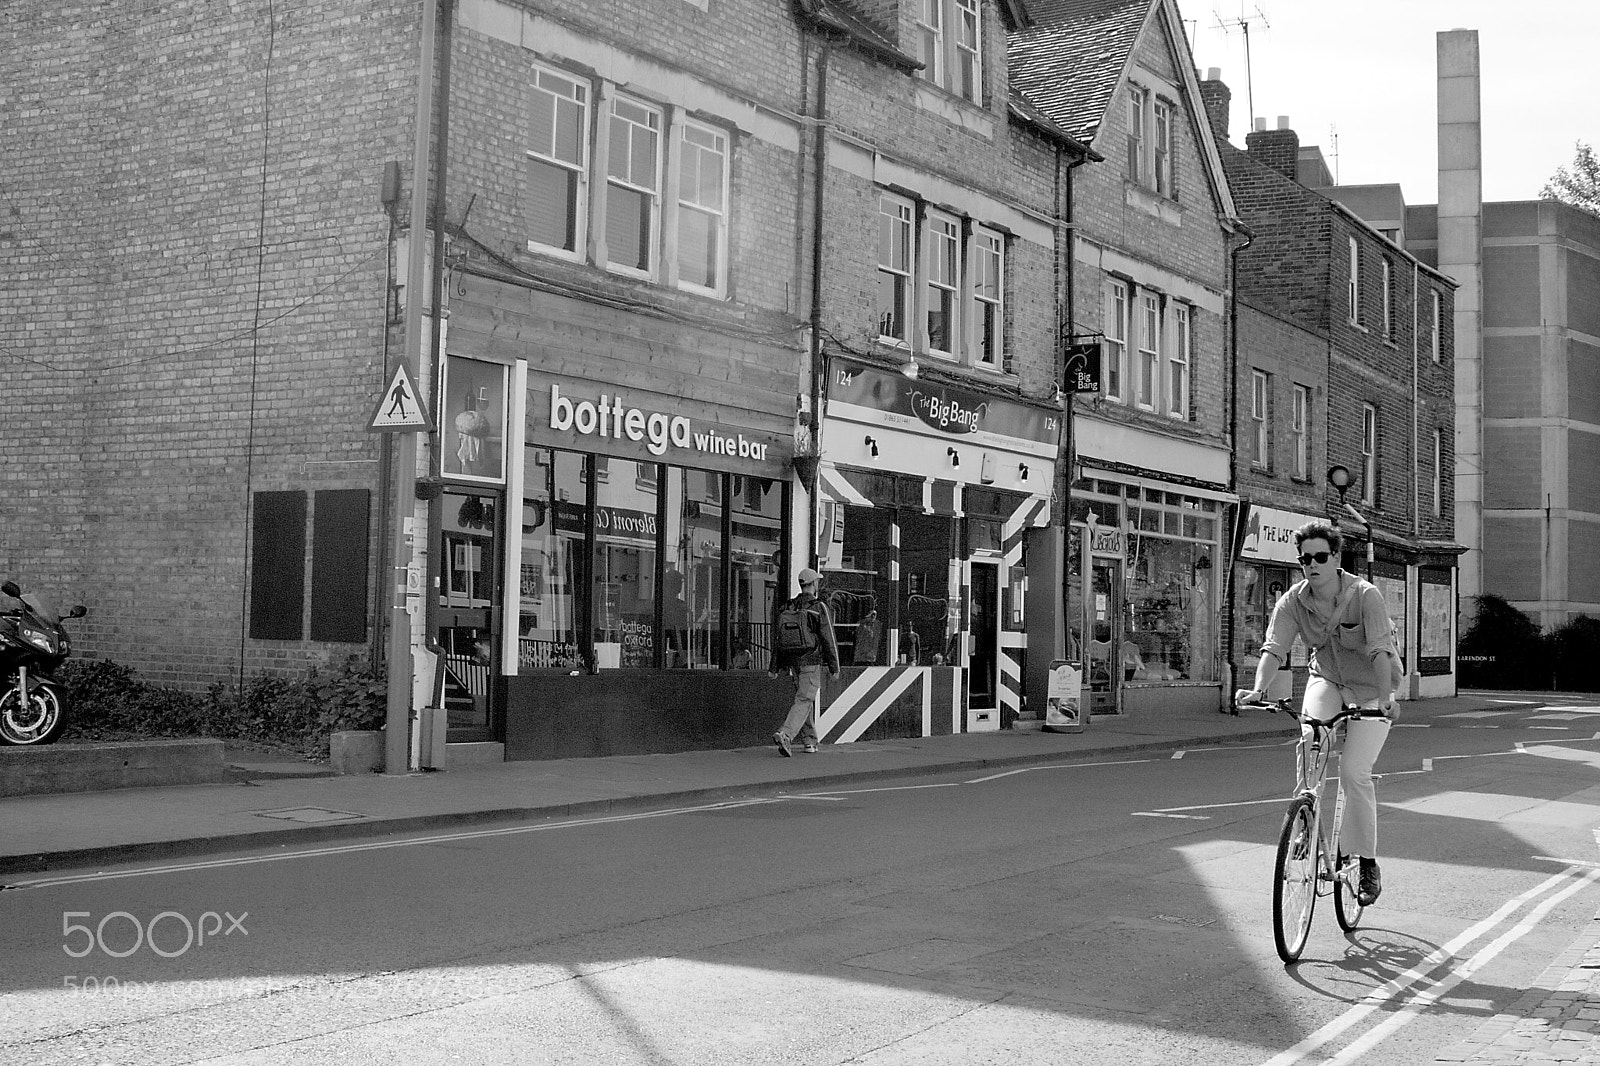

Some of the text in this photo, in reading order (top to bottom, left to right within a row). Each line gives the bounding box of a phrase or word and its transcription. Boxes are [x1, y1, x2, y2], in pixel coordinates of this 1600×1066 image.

[835, 369, 852, 387] 124
[1078, 373, 1091, 383] Big
[1078, 381, 1098, 391] Bang
[549, 384, 691, 456] bottega
[920, 395, 980, 433] The Big Bang
[1044, 416, 1057, 431] 124
[1263, 525, 1276, 542] THE
